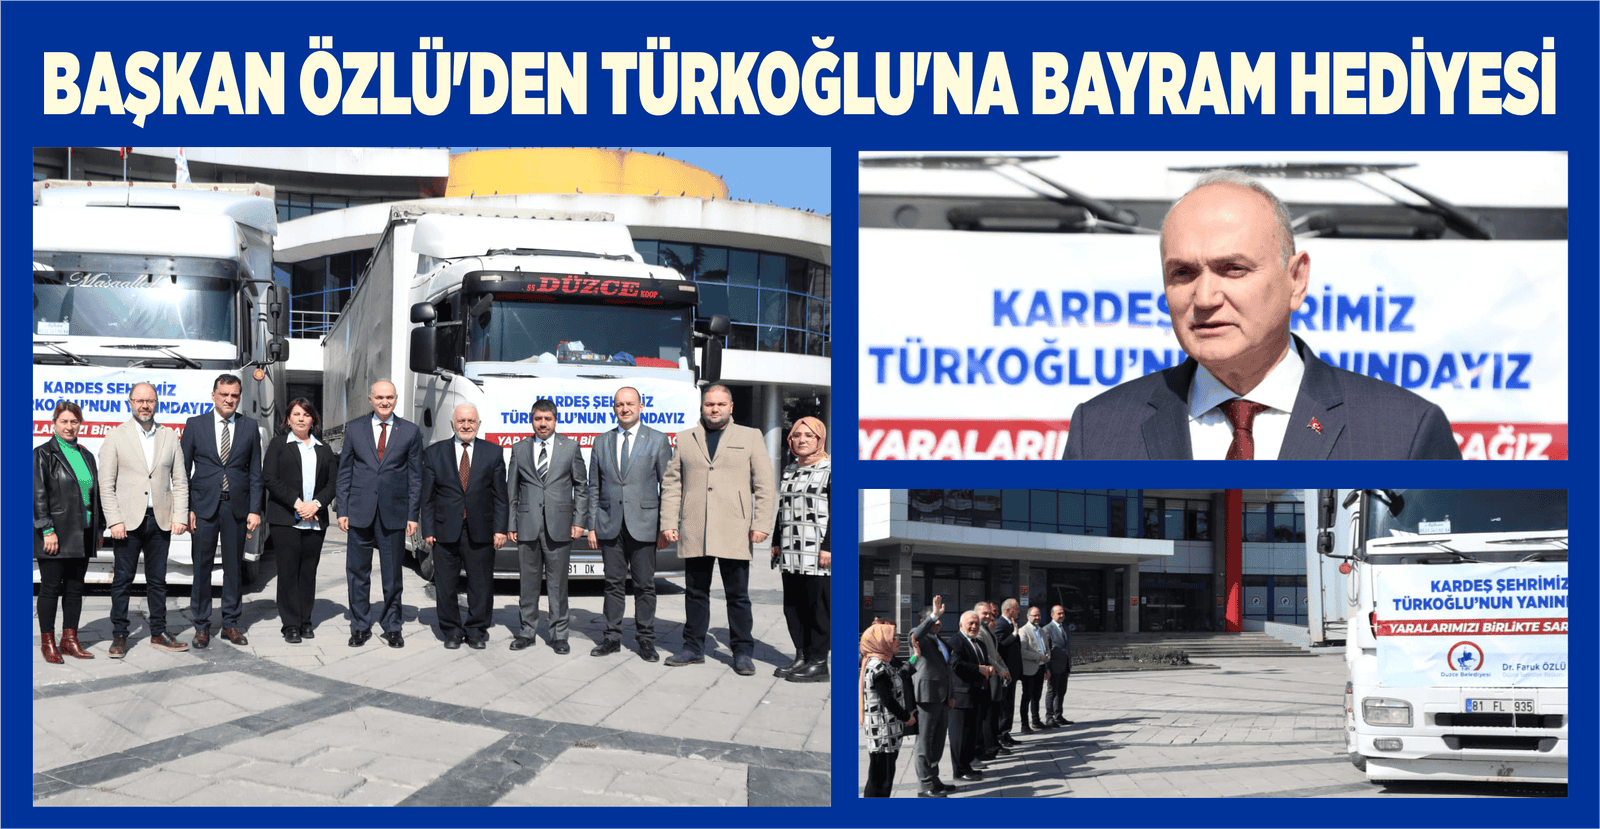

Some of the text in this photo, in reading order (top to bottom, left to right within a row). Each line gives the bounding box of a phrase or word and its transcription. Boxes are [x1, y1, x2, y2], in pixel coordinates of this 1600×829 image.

[537, 275, 641, 297] DÜZCE
[640, 290, 658, 299] KOOP
[1291, 285, 1416, 332] RİMİZ
[868, 336, 1188, 386] TÜRKOĞLU'N
[501, 409, 684, 424] TÜRLU'NUN YNDAYIZ
[858, 429, 1069, 460] YARALARI
[1431, 575, 1568, 593] KARDEŞ ŞEHRİMİZ
[1393, 595, 1568, 611] TÜRKOĞLU'NUN YANIN
[1389, 623, 1479, 633] YARALARIMIZI
[1542, 621, 1568, 632] SAR
[1502, 661, 1566, 671] Dr. Faruk ÖZLÜ
[1472, 701, 1533, 712] 81 FL 935
